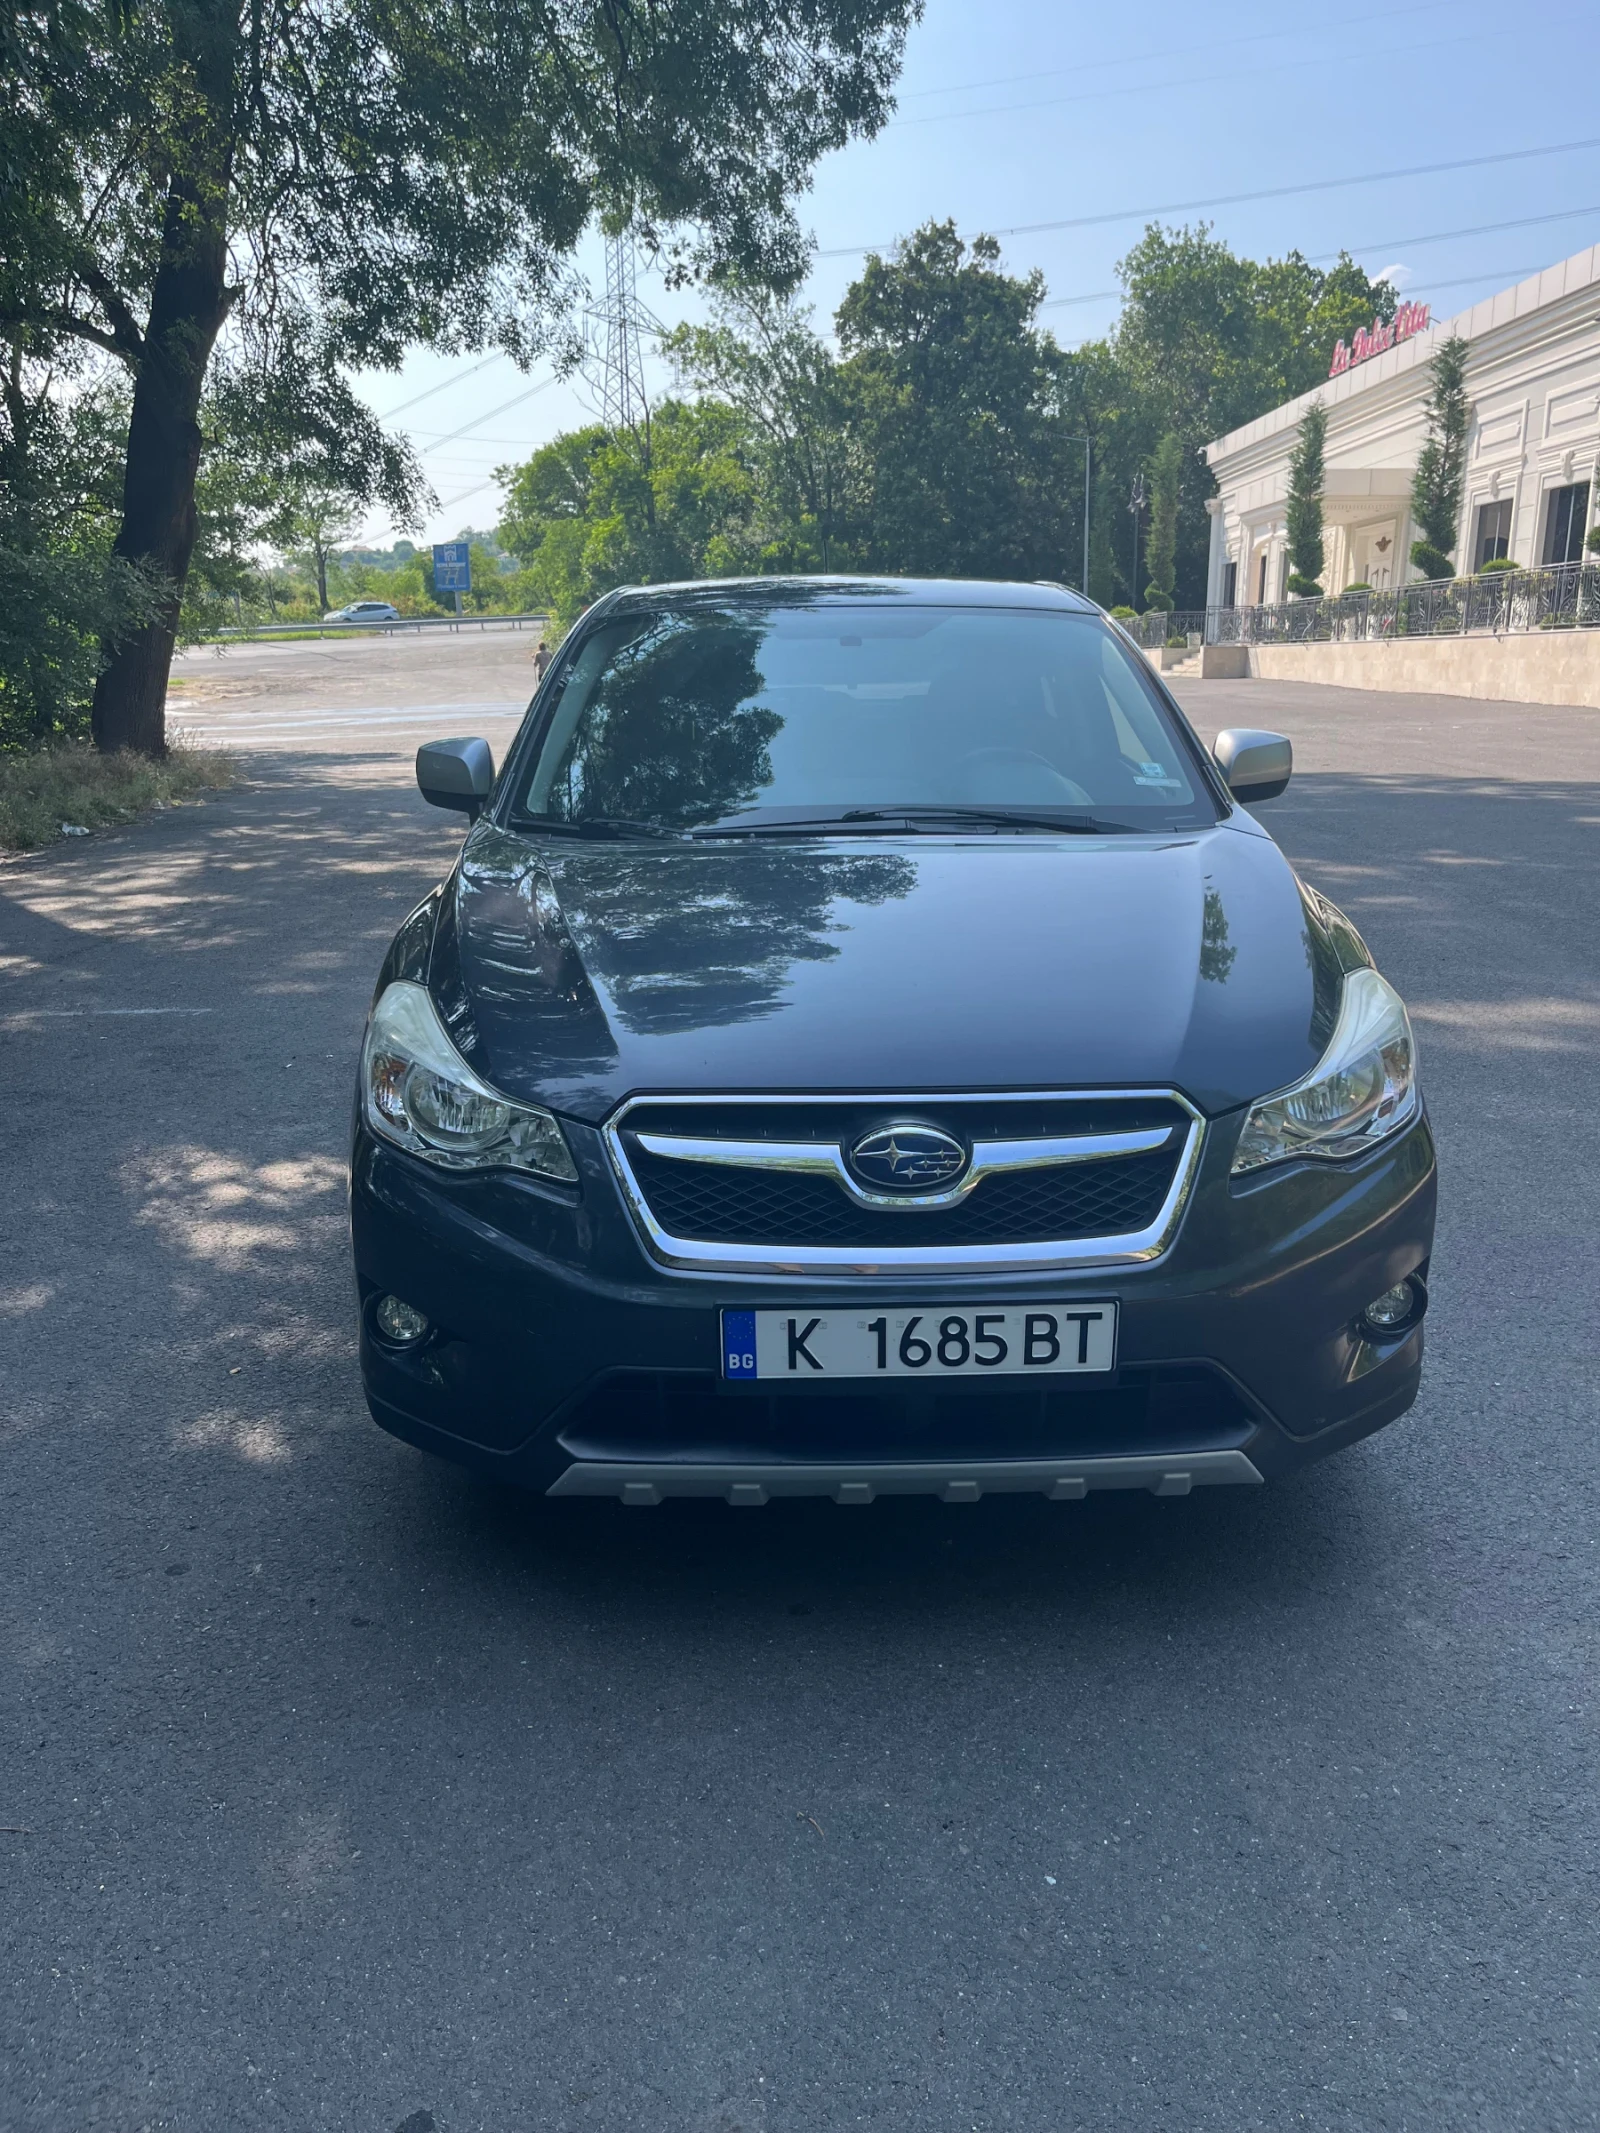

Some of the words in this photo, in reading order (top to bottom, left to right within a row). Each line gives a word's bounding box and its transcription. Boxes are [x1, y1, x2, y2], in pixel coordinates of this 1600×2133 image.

[1328, 339, 1351, 378] La
[1350, 316, 1394, 367] Dolce
[1394, 300, 1430, 343] Vita
[729, 1353, 754, 1369] BG
[787, 1317, 824, 1370] K
